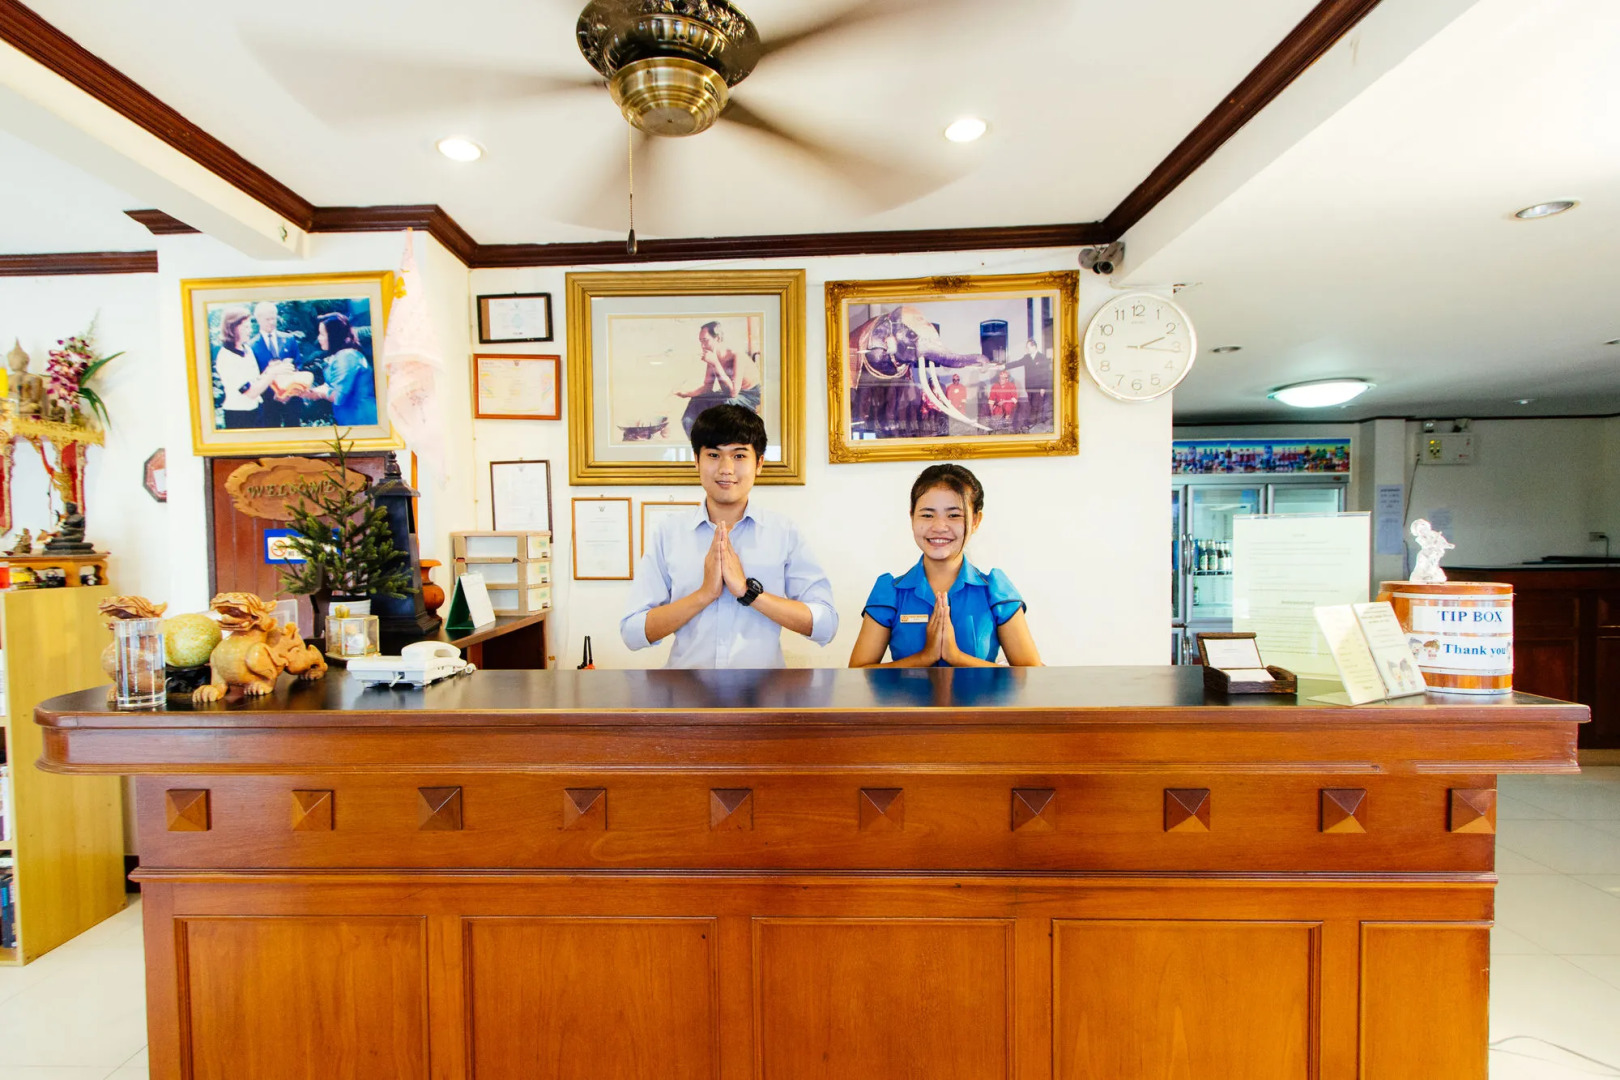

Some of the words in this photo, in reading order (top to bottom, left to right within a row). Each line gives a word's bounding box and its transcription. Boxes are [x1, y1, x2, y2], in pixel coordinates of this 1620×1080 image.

[1115, 309, 1125, 321] 11
[1132, 304, 1145, 317] 12
[1100, 324, 1114, 337] 10
[1166, 322, 1176, 335] 2
[1095, 342, 1106, 354] 9
[1173, 342, 1181, 353] 3
[1100, 360, 1111, 372] 8
[1164, 360, 1173, 372] 4
[1116, 374, 1125, 386] 7
[1131, 379, 1142, 391] 6
[1150, 374, 1161, 386] 5
[1437, 611, 1467, 622] TIP
[1473, 611, 1502, 622] BOX
[1443, 643, 1487, 655] Thank
[1490, 647, 1506, 658] you
